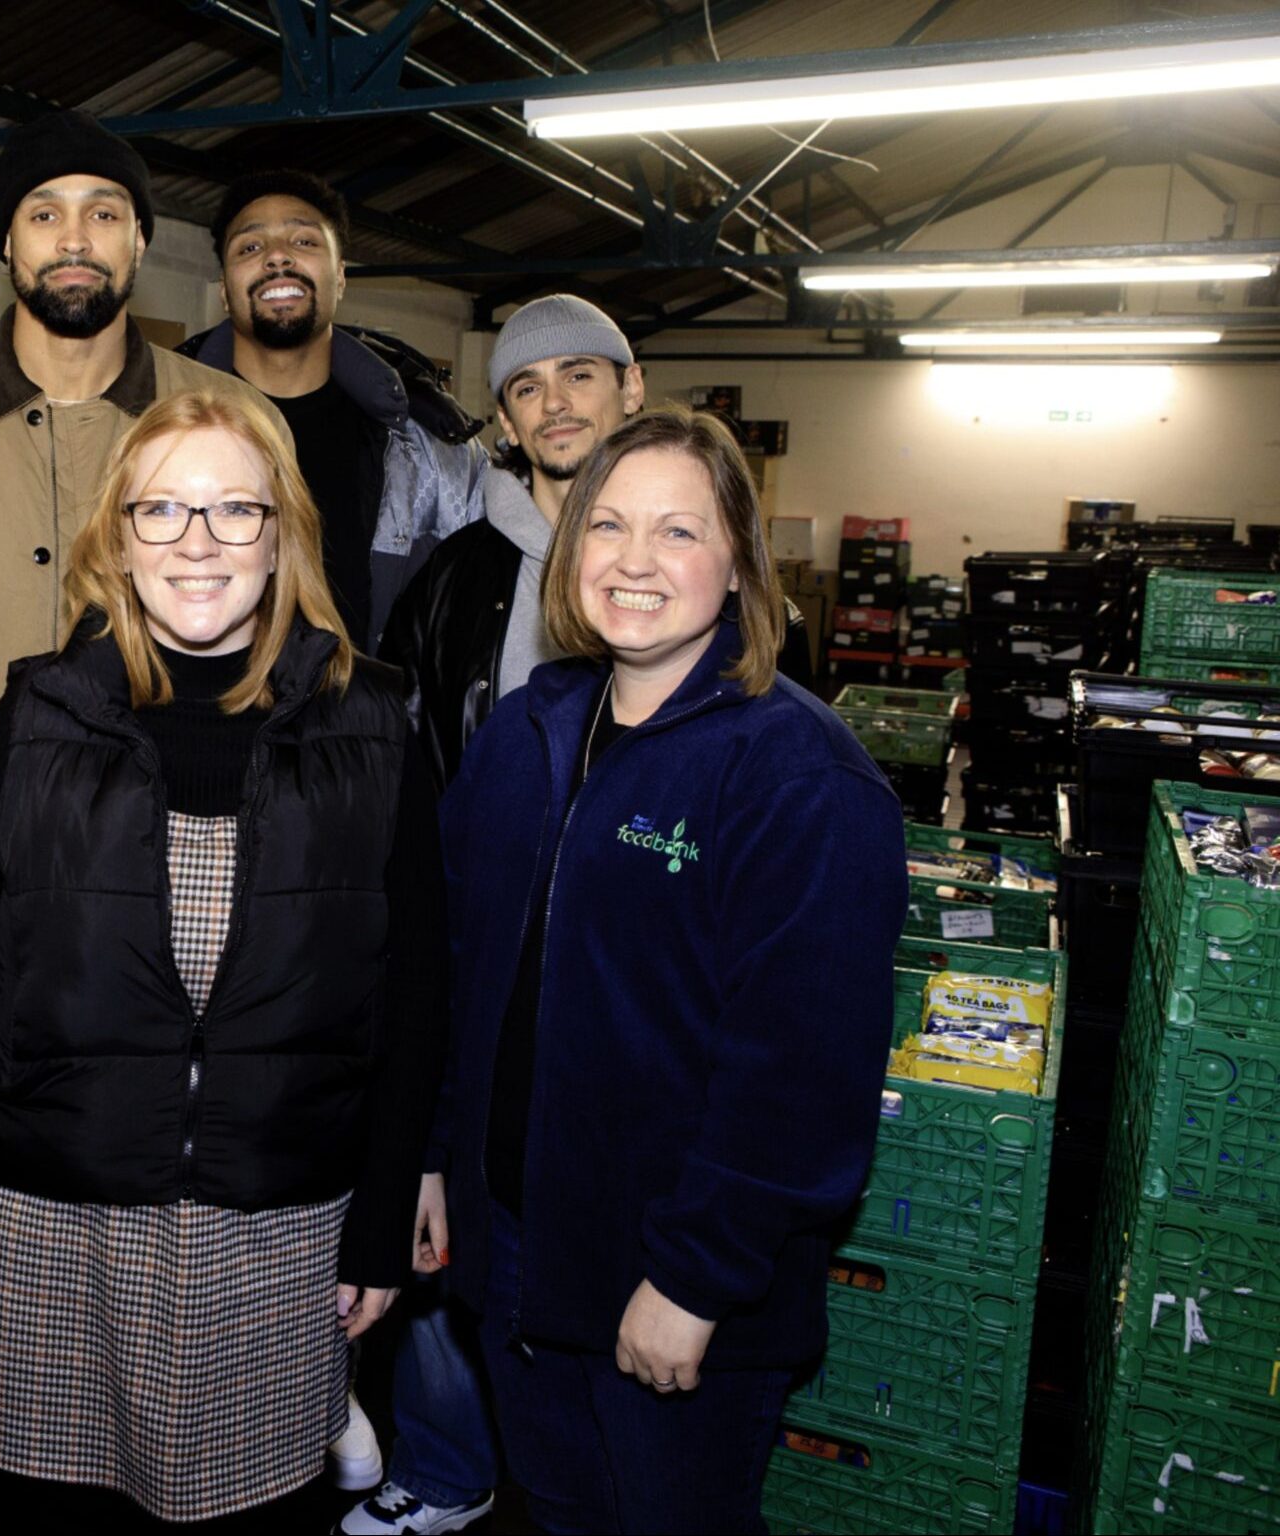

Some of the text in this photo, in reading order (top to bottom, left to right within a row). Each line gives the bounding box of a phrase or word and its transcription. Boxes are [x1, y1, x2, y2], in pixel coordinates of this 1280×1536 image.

[944, 995, 959, 1003] 40
[959, 996, 980, 1005] TEA
[982, 1000, 1010, 1011] BAGS
